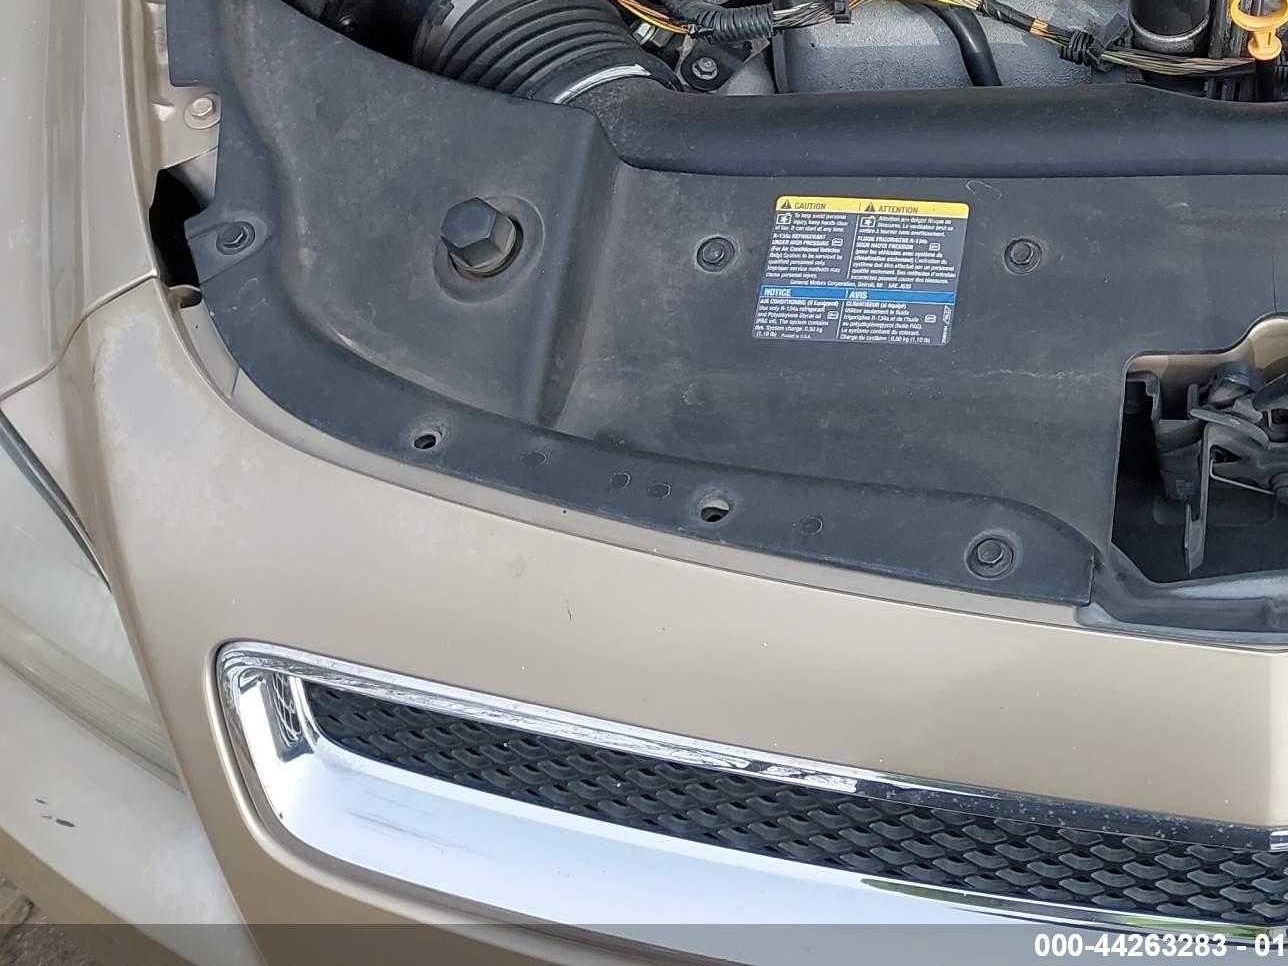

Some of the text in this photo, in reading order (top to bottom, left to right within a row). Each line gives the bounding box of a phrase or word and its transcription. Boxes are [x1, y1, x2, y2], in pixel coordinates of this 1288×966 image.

[878, 205, 918, 213] ATTENTION
[764, 288, 791, 296] NOTICE
[849, 291, 868, 299] AVIS
